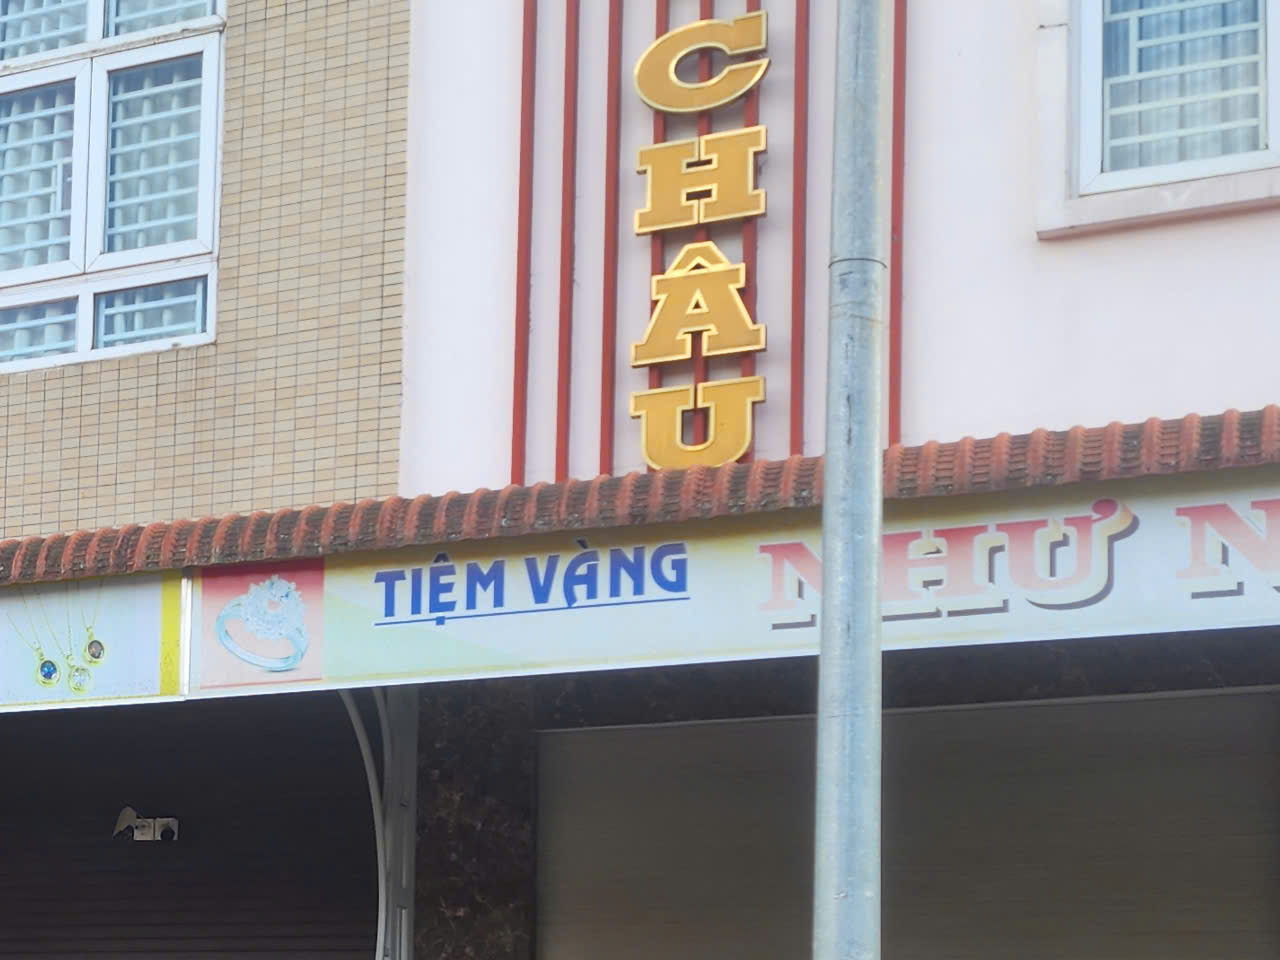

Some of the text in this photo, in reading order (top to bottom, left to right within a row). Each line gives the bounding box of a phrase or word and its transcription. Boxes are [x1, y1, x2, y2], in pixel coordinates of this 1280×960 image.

[629, 9, 771, 470] CHÂU
[374, 539, 689, 626] TIỆM VÀNG
